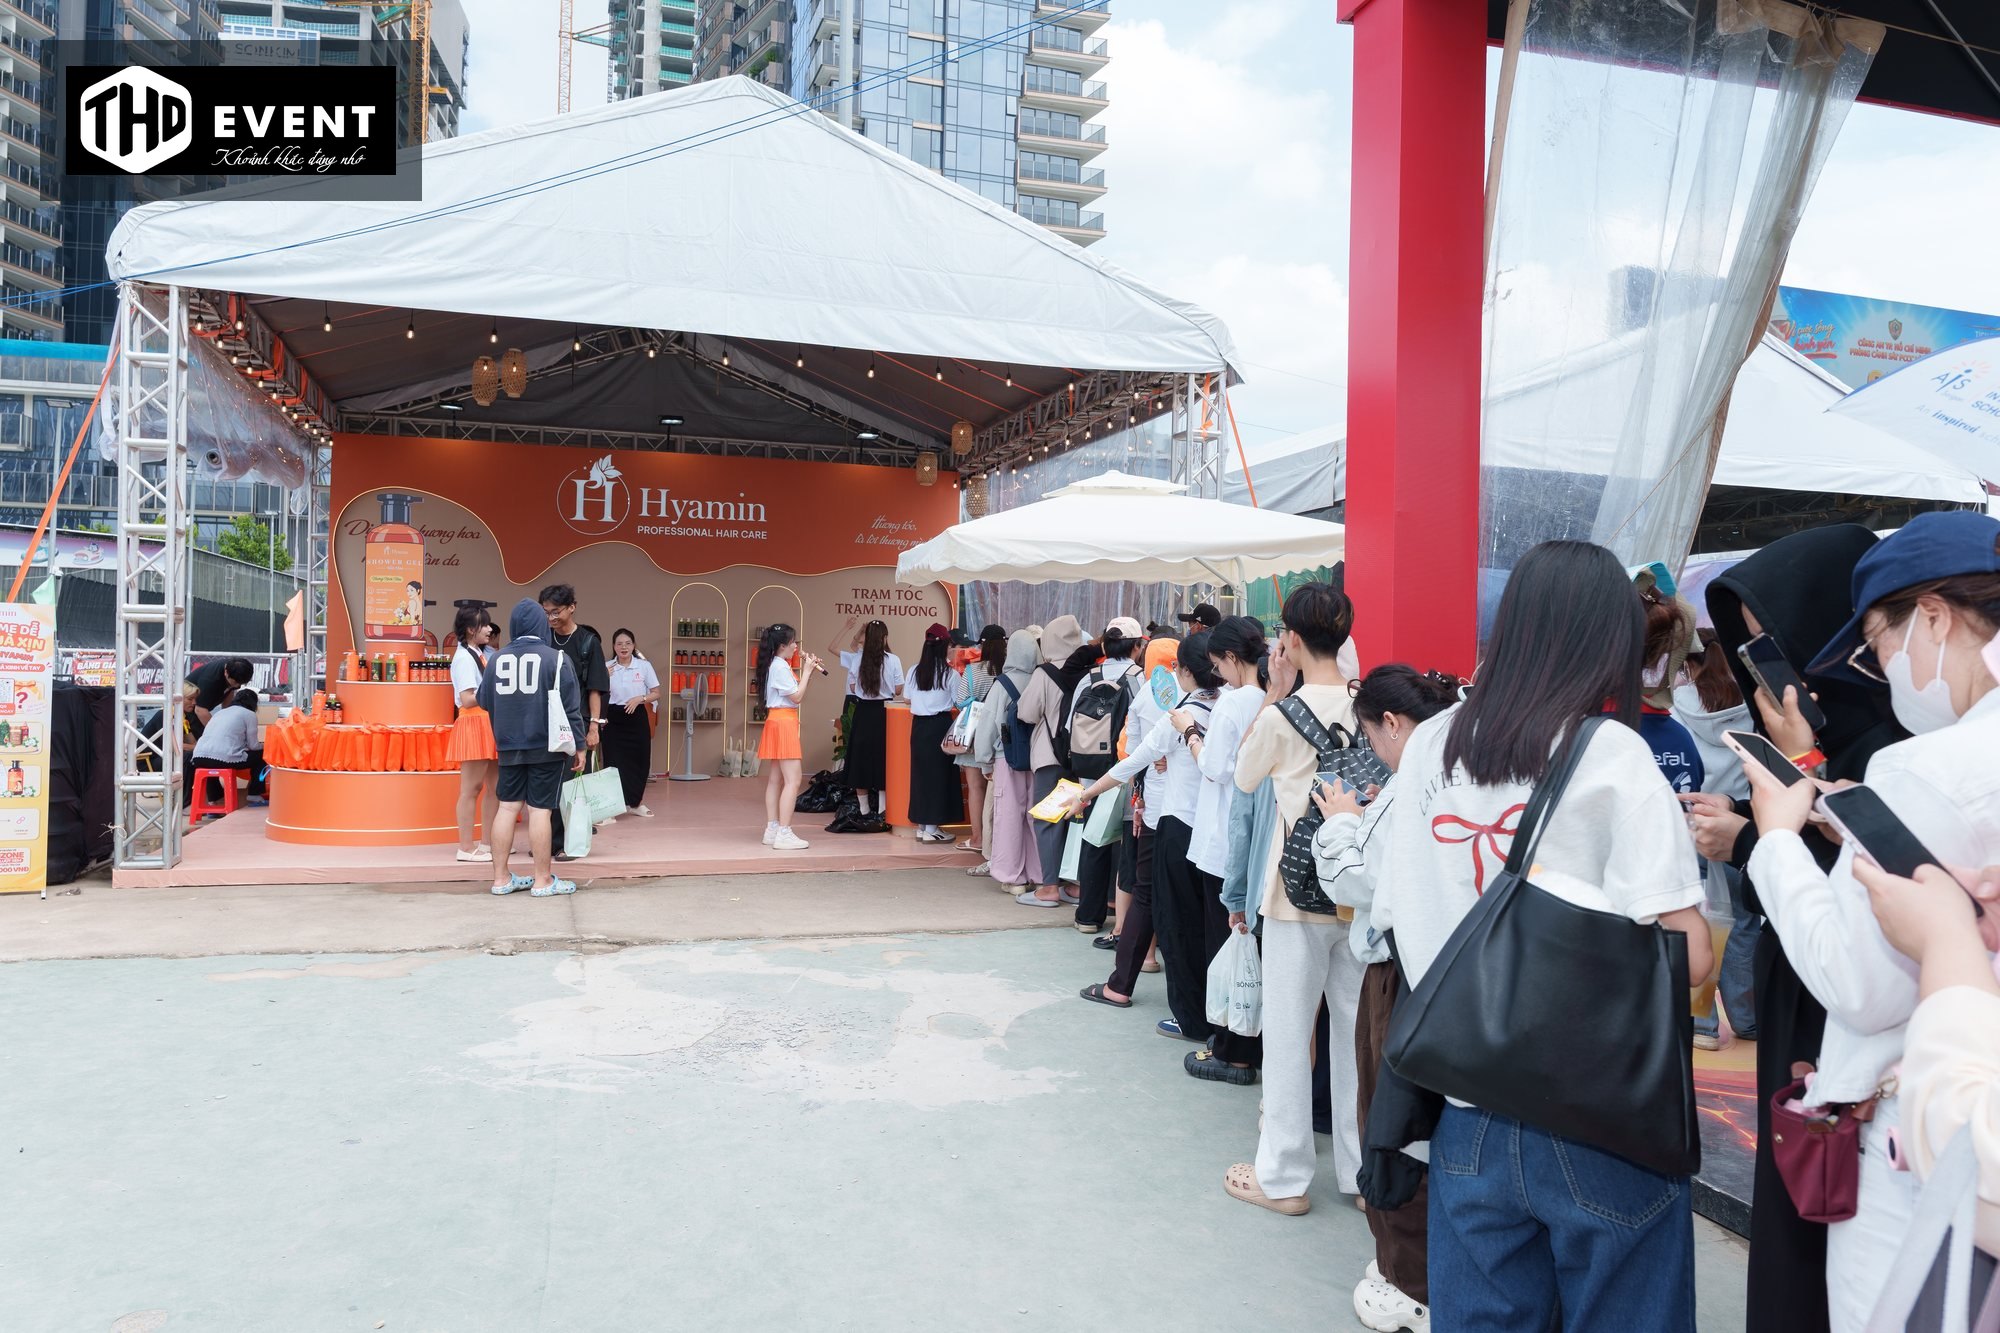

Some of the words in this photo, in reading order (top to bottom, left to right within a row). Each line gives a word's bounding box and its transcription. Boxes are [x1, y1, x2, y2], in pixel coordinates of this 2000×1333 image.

[639, 487, 768, 525] Hyamin
[344, 519, 374, 538] Dị
[457, 526, 482, 539] hoa
[637, 525, 714, 538] PROFESSIONAL
[715, 528, 739, 539] HAIR
[740, 530, 768, 540] CARE
[442, 553, 460, 566] da
[851, 588, 891, 603] TRẠM
[896, 585, 923, 601] TÓC
[835, 603, 875, 618] TRẠM
[879, 605, 938, 617] THƯƠNG
[0, 622, 18, 635] ME
[0, 634, 16, 647] UÀ
[17, 637, 45, 652] XỊN
[495, 653, 542, 695] 90
[1653, 752, 1691, 766] efal
